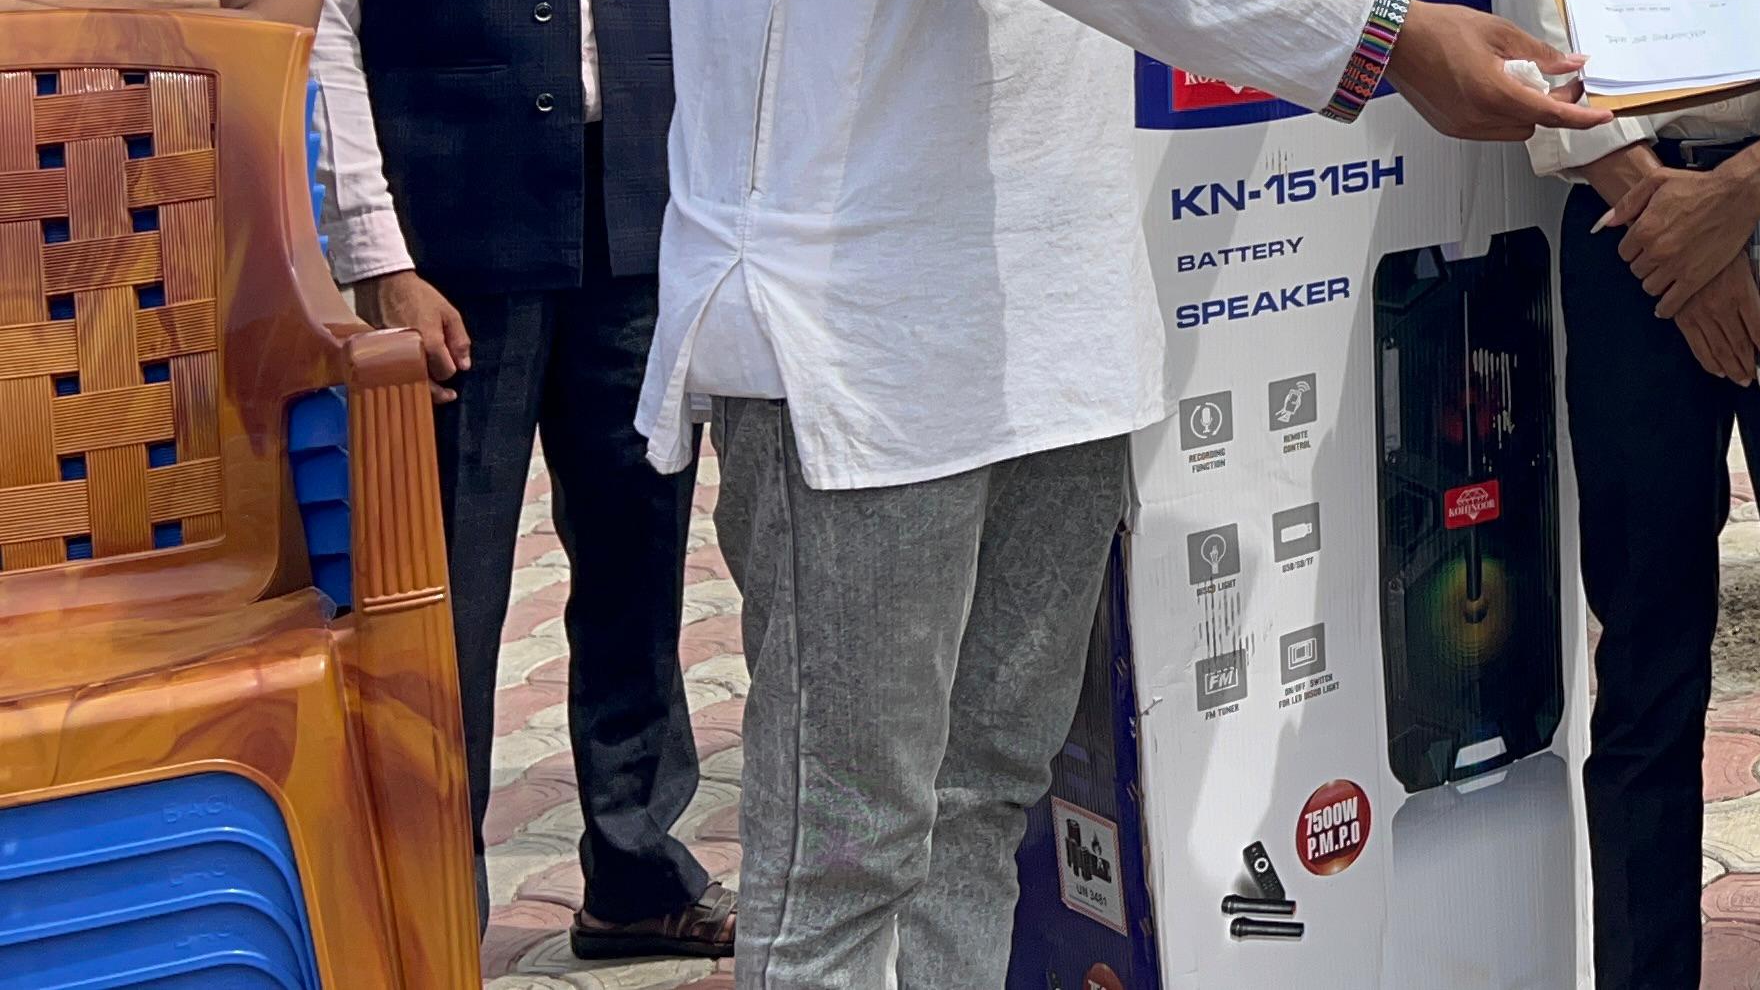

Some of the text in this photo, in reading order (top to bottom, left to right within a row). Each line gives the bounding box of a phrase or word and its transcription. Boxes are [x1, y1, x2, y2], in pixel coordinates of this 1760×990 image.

[1171, 155, 1404, 220] KN-1515H
[1177, 236, 1304, 273] BATTERY
[1175, 276, 1350, 329] SPEAKER
[1283, 430, 1309, 443] REMOTE
[1188, 448, 1226, 463] RECORDING
[1283, 441, 1311, 454] CONTROL
[1191, 459, 1226, 473] FUNCTION
[1217, 579, 1236, 591] LIGHT
[1208, 669, 1234, 690] FM
[1278, 697, 1290, 709] FOR
[1323, 682, 1340, 694] LIGHT
[1205, 703, 1239, 720] FM TUNER
[1304, 796, 1358, 836] 7500W
[1306, 821, 1361, 861] P.M.P.O
